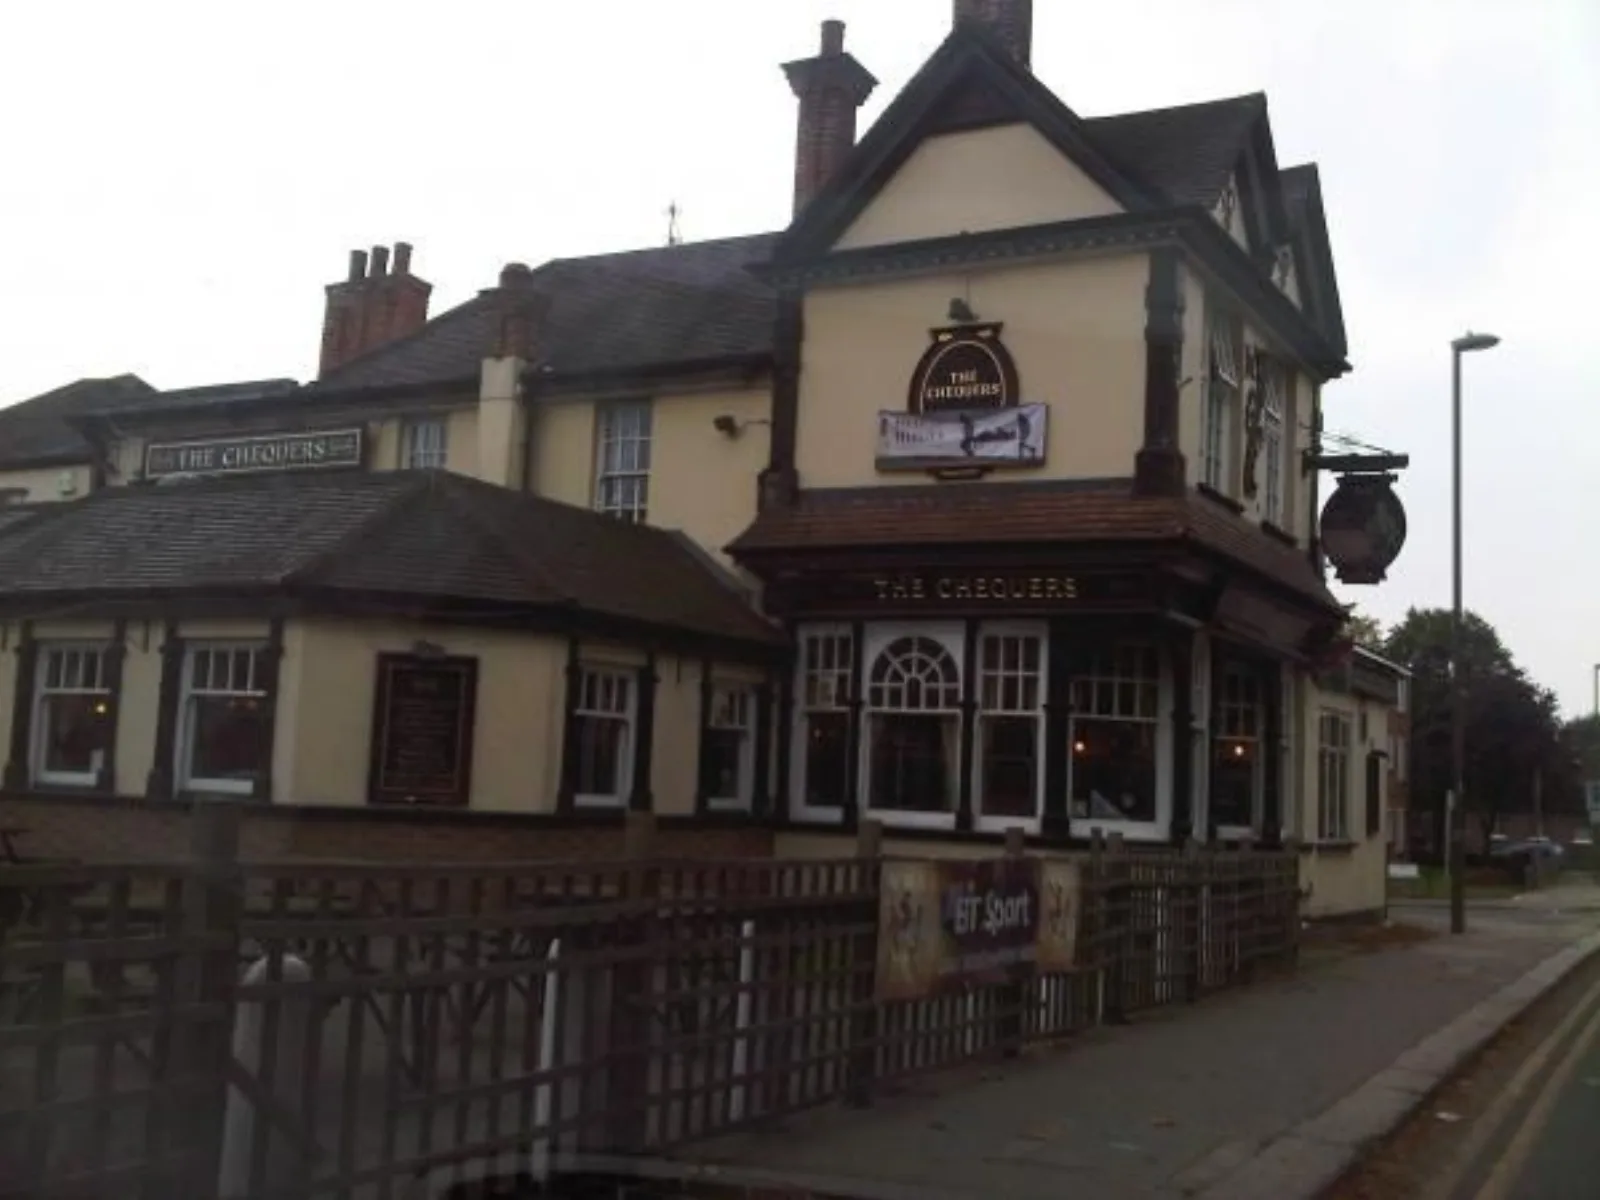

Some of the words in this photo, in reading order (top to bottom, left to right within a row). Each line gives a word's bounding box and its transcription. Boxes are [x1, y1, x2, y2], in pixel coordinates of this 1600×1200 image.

[950, 368, 978, 385] THE
[927, 382, 1001, 399] CHEQUERS
[178, 449, 214, 471] THE
[222, 440, 326, 470] CHEQUERS
[874, 577, 926, 599] THE
[936, 577, 1078, 600] CHEQUERS
[953, 895, 982, 936] BT
[983, 888, 1031, 937] Sport
